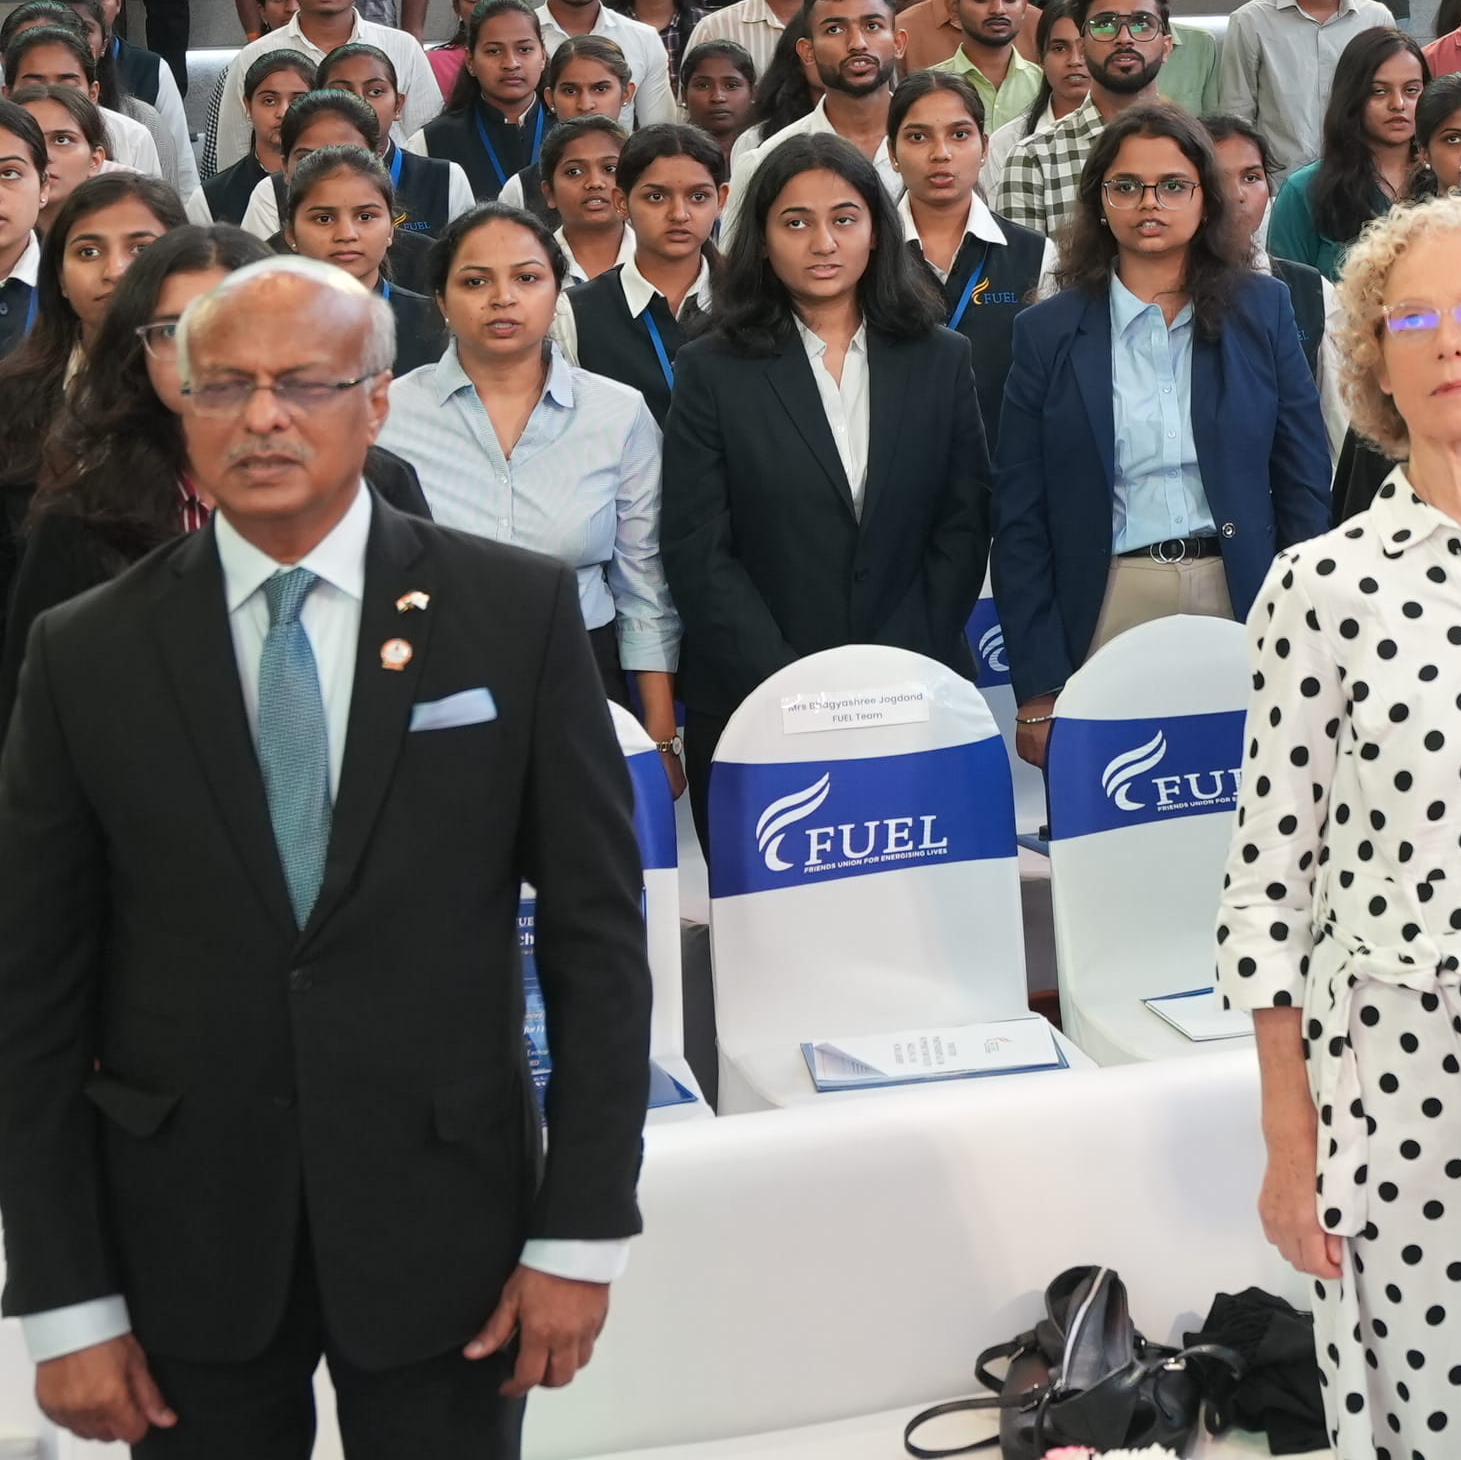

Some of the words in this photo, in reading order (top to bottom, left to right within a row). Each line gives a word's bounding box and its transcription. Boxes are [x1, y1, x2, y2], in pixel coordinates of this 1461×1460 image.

[832, 714, 853, 723] FUEL
[856, 712, 883, 722] Team
[1157, 802, 1188, 812] FRIENDS
[805, 815, 947, 866] FUEL
[804, 863, 836, 873] FRIENDS
[838, 859, 862, 868] UNION
[881, 850, 925, 862] ENERGISING
[927, 847, 947, 856] LIVES
